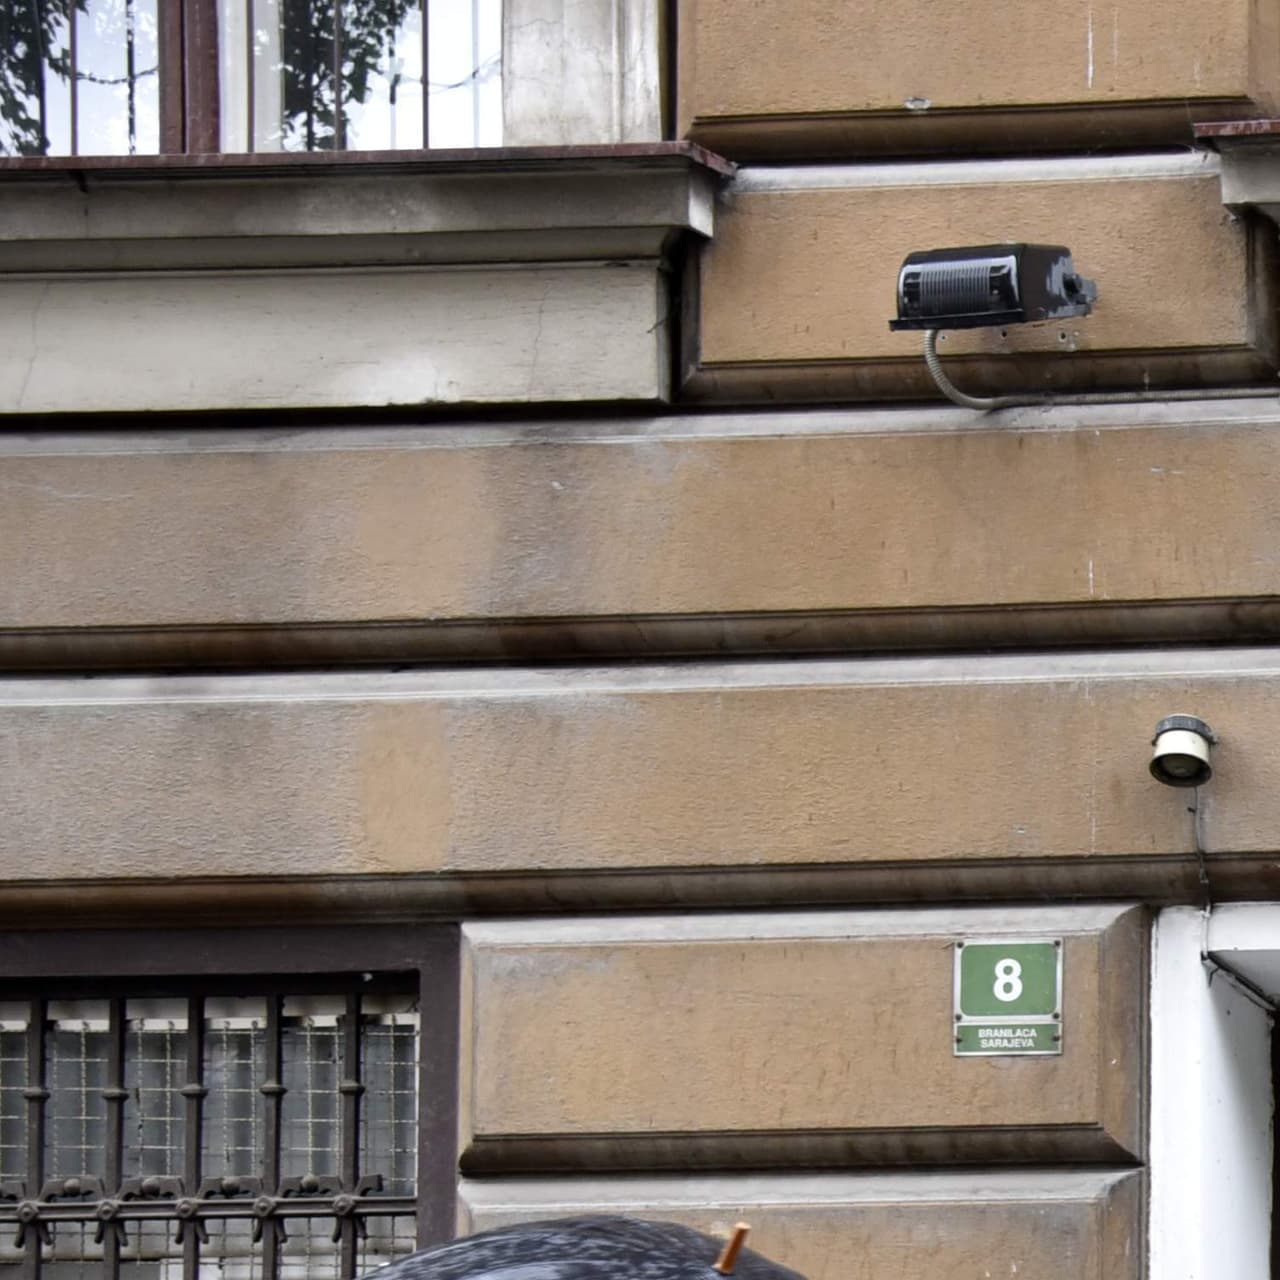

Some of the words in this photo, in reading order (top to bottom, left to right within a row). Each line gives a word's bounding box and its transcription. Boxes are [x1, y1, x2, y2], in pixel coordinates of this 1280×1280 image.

[993, 958, 1023, 1002] 8
[978, 1028, 1037, 1038] BRANILACA
[980, 1038, 1035, 1048] SARAJEVA
